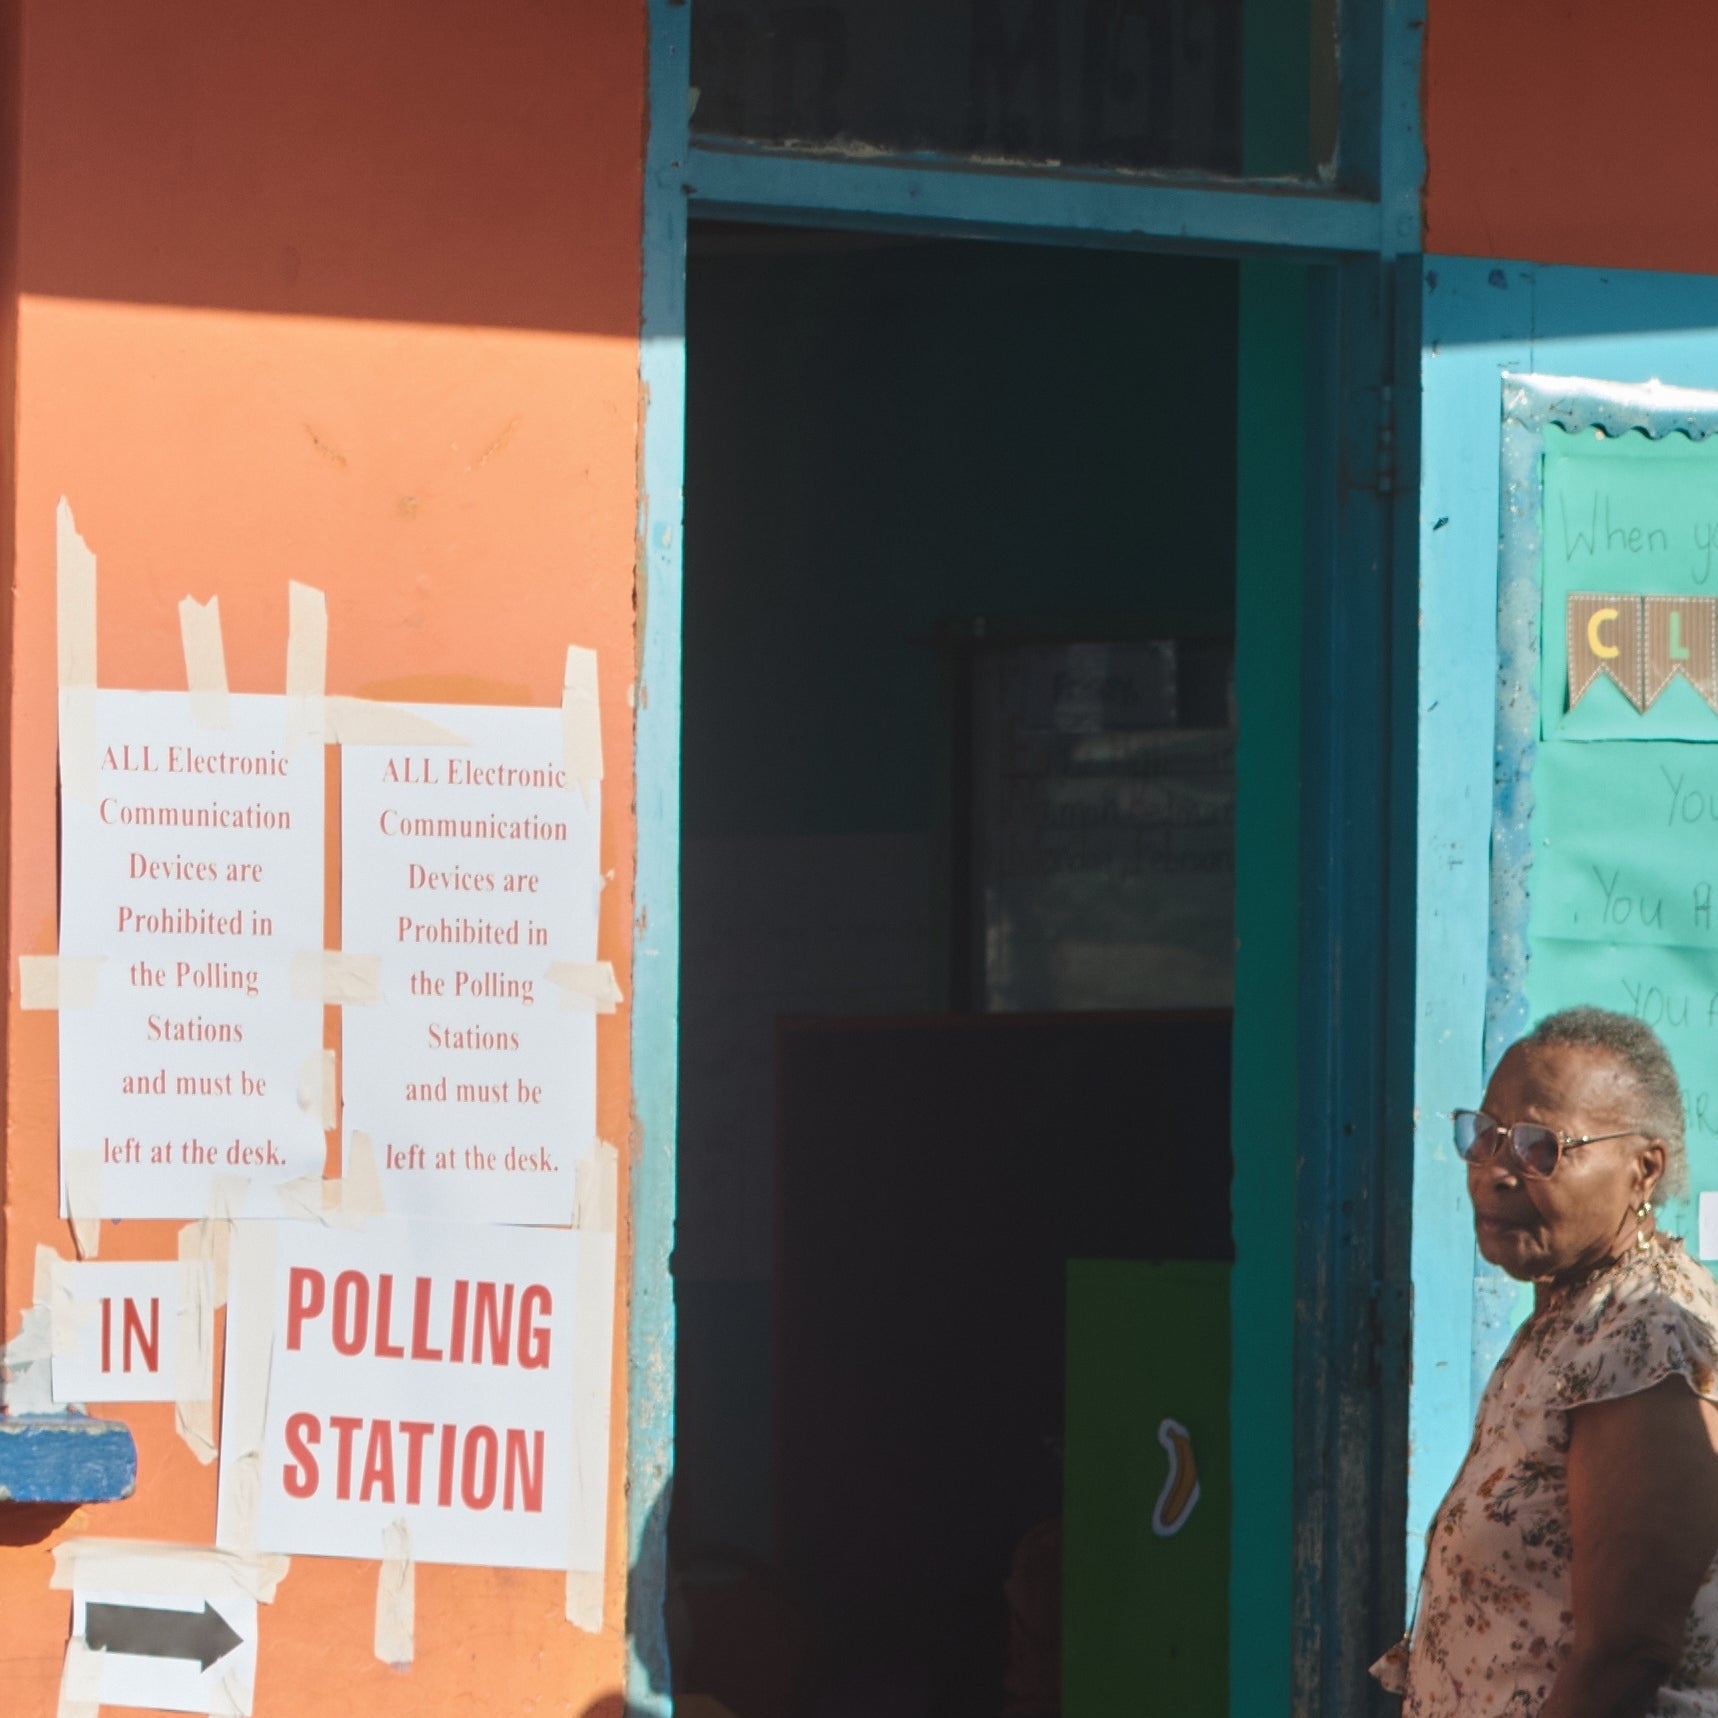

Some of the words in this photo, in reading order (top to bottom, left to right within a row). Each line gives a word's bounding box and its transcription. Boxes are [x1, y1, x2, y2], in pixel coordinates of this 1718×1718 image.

[1560, 491, 1668, 562] When
[102, 744, 158, 773] ALL
[168, 746, 288, 776] Electronic
[383, 756, 439, 785] ALL
[447, 758, 566, 789] Electronic
[99, 799, 292, 830] Communication
[379, 810, 568, 841] Communication
[129, 852, 218, 880] Devices
[226, 864, 262, 883] are
[409, 863, 496, 891] Devices
[503, 874, 539, 893] are
[118, 906, 243, 936] Prohibited
[251, 911, 273, 936] in
[398, 916, 520, 945] Prohibited
[528, 922, 549, 945] in
[130, 962, 165, 986] the
[176, 961, 259, 996] Polling
[410, 970, 444, 996] the
[455, 971, 534, 1003] Polling
[147, 1016, 243, 1042] Stations
[428, 1026, 520, 1050] Stations
[122, 1069, 167, 1095] and
[175, 1075, 231, 1096] must
[240, 1072, 264, 1096] be
[405, 1077, 447, 1101] and
[456, 1083, 509, 1103] must
[517, 1080, 540, 1104] be
[103, 1138, 141, 1164] left
[151, 1143, 172, 1164] at
[181, 1139, 218, 1165] the
[225, 1139, 286, 1166] desk.
[386, 1144, 426, 1170] left
[435, 1149, 455, 1170] at
[464, 1147, 495, 1170] the
[504, 1147, 558, 1172] desk.
[286, 1267, 553, 1370] POLLING
[101, 1298, 160, 1373] IN
[283, 1412, 545, 1513] STATION
